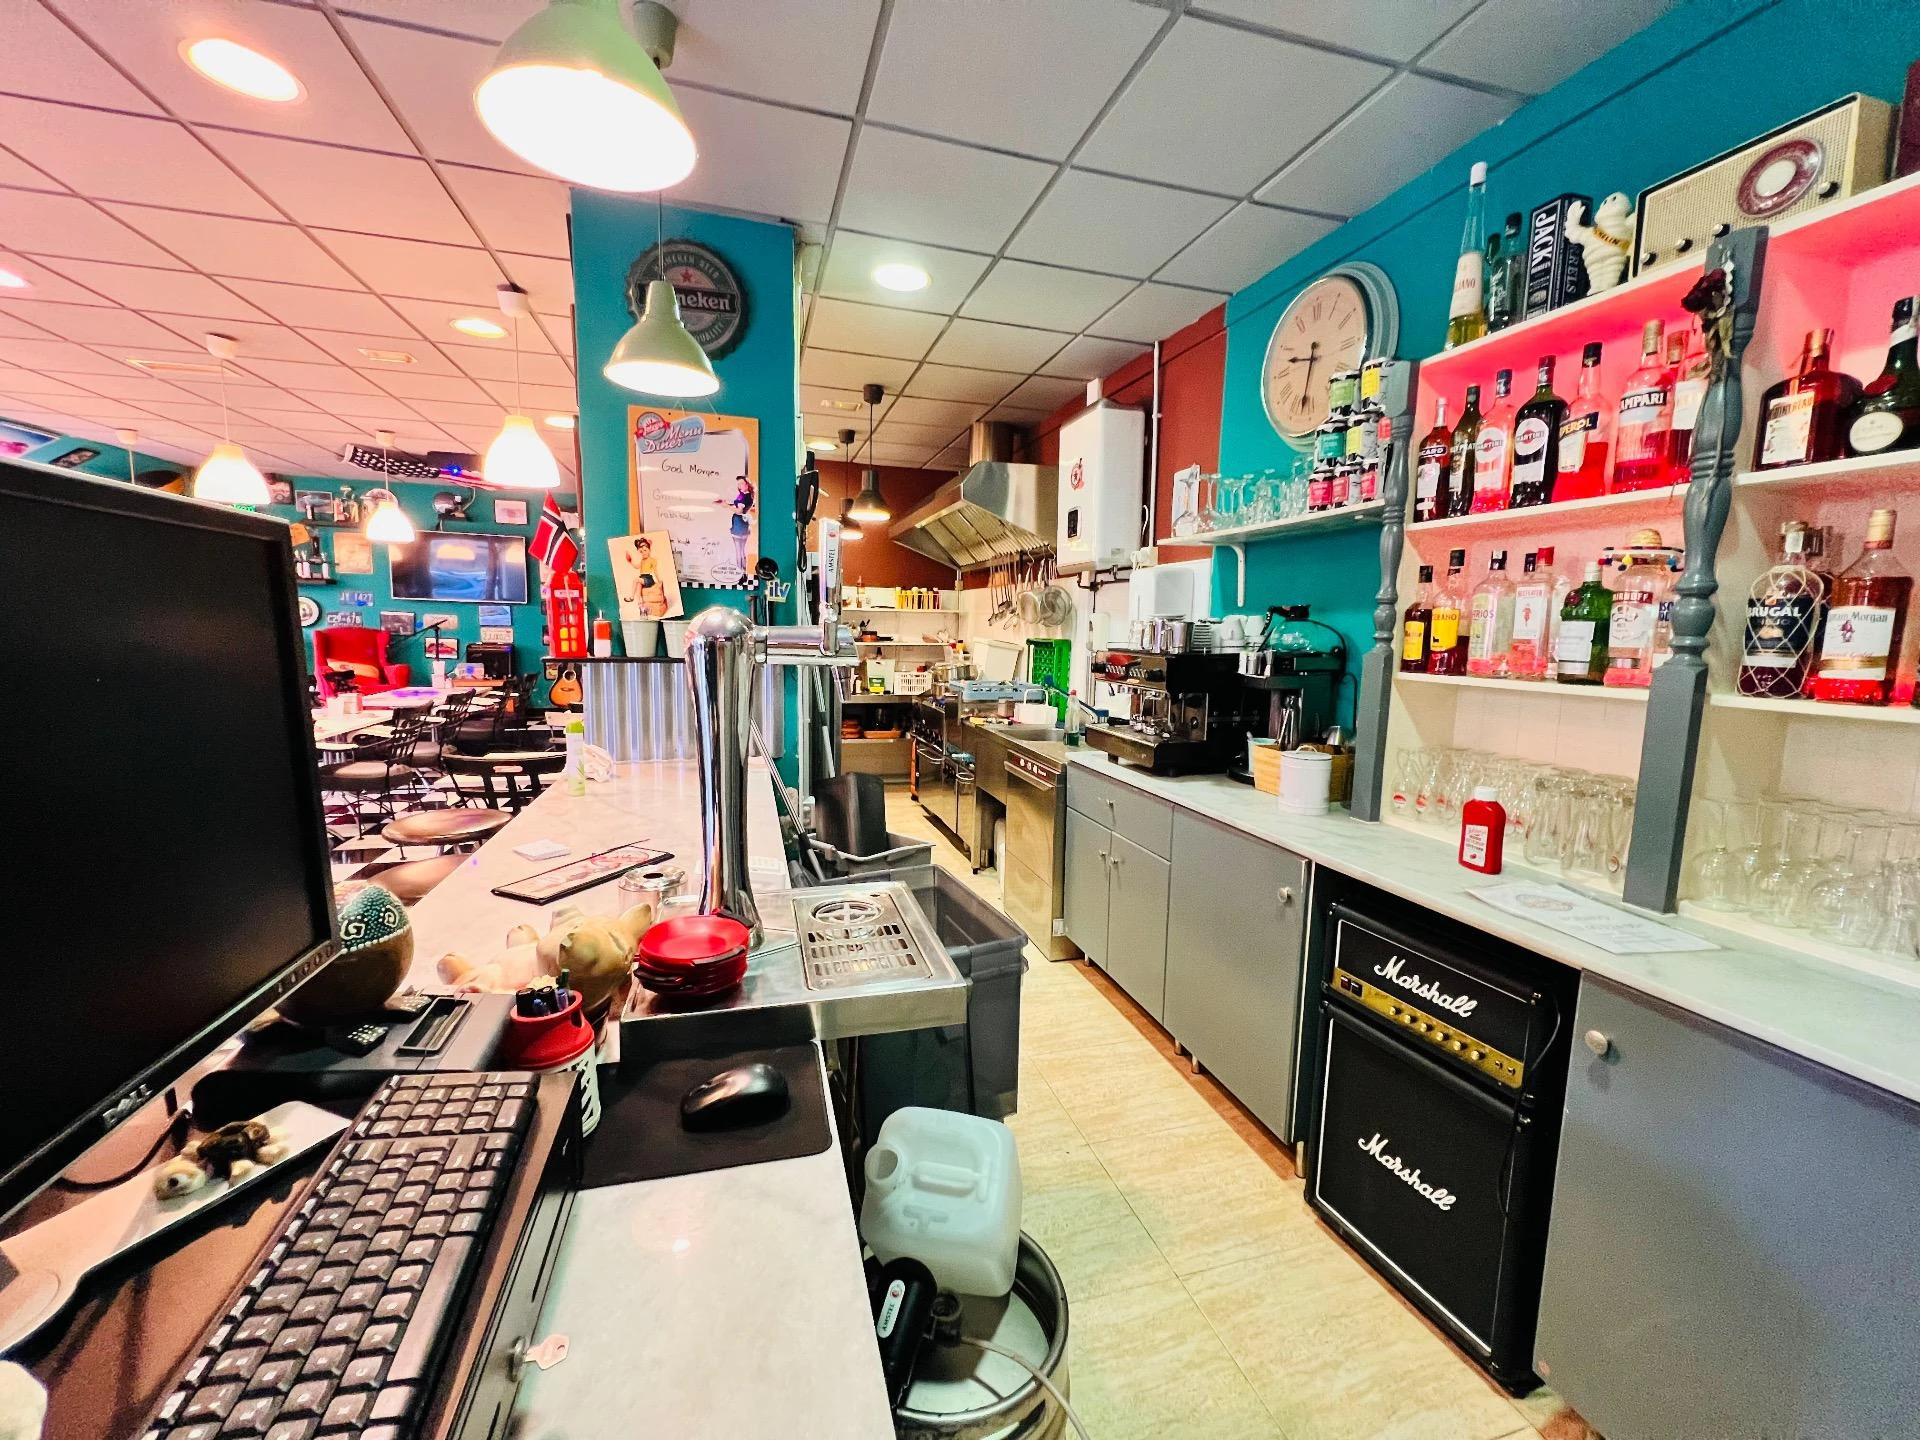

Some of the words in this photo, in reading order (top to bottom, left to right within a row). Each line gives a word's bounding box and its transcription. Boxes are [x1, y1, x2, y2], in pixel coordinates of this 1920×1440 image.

[1531, 212, 1556, 267] JACK
[676, 291, 731, 310] neken
[1619, 391, 1666, 411] AMPARI
[667, 424, 703, 441] Menu
[1559, 416, 1592, 437] PEROL
[828, 549, 836, 574] AMSTEL
[1373, 955, 1478, 1018] Marshall
[1357, 1132, 1457, 1211] Marshall
